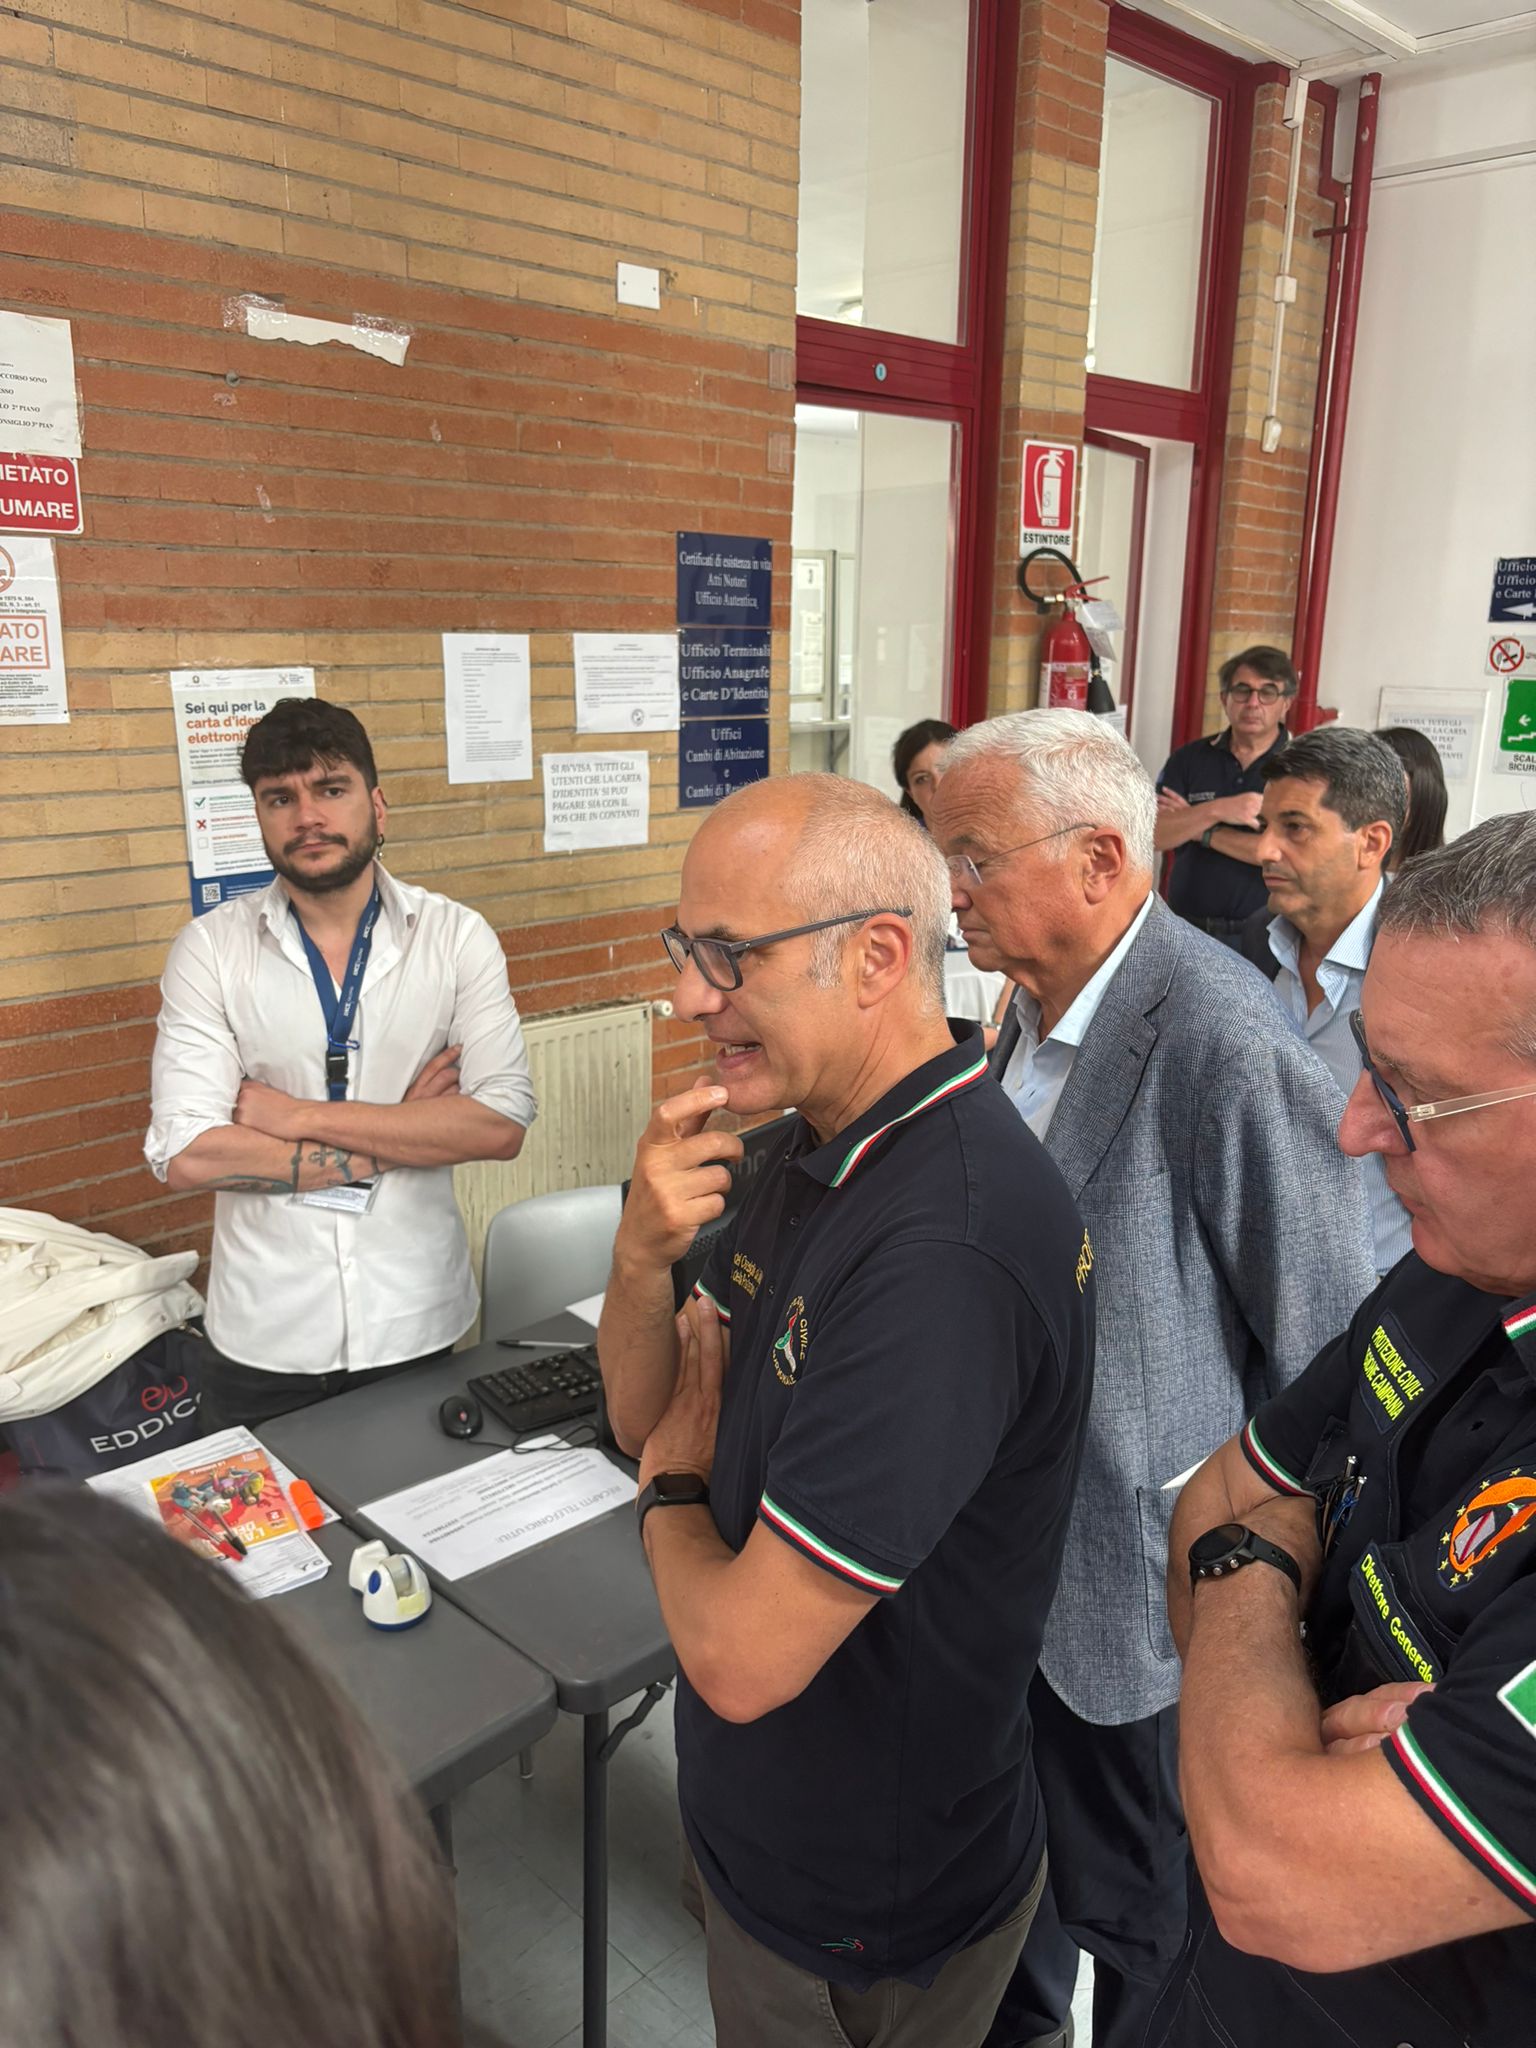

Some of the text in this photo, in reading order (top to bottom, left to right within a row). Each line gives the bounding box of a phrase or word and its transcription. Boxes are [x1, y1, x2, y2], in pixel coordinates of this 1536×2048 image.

[0, 464, 69, 486] IETATO
[0, 498, 75, 519] UMARE
[1023, 532, 1071, 545] ESTINTORE
[715, 552, 722, 567] di
[752, 556, 759, 570] in
[1499, 559, 1536, 571] Ufficio
[707, 573, 747, 588] Atti Notori
[1497, 574, 1536, 586] Ufficio
[695, 591, 722, 606] Ufficio
[1495, 588, 1532, 599] e Carte
[0, 622, 39, 639] ATO
[0, 646, 43, 662] ARE
[681, 643, 770, 657] Ufficio Terminali
[681, 665, 769, 682] Ufficio Anagrafe
[690, 688, 719, 701] Carte
[185, 700, 266, 716] Sei qui per la
[186, 714, 263, 729] carta d'iden
[188, 730, 249, 744] elettronic
[711, 727, 742, 741] Uffici
[685, 747, 765, 763] Cambi di Abitazione
[1513, 754, 1536, 763] SCAL
[593, 762, 619, 772] TUTTI
[620, 761, 634, 771] GLI
[724, 769, 730, 778] e
[551, 773, 642, 786] UTENTI CHE LA CARTA
[601, 787, 609, 796] SI
[685, 784, 713, 799] Cambi
[714, 783, 723, 797] di
[552, 798, 630, 811] PAGARE SIA CON IL
[552, 808, 640, 823] POS CHE IN CONTANTI
[1371, 1325, 1425, 1401] PROTEZIONE CIVILE
[89, 1392, 202, 1454] EDDIC
[525, 1501, 579, 1532] TELEFONICI
[1360, 1553, 1390, 1620] Direttore
